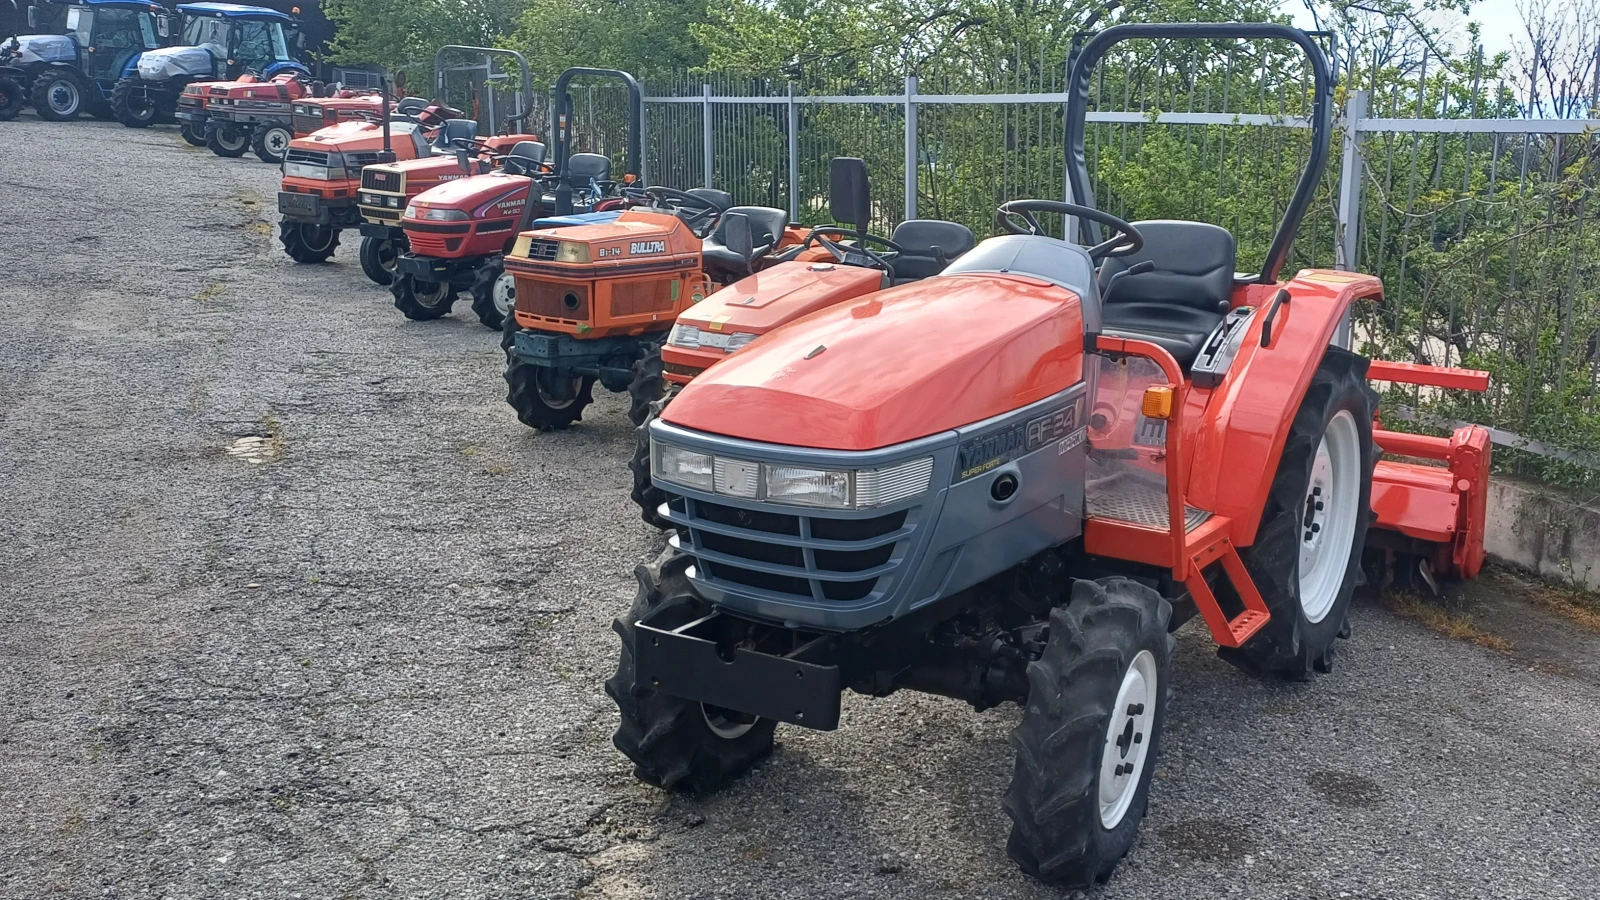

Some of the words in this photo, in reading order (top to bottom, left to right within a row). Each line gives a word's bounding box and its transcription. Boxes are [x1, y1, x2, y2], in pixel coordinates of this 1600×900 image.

[496, 199, 526, 209] YANMAR
[630, 240, 666, 255] BULLTRA
[961, 427, 1025, 469] YANMAR
[961, 465, 982, 478] SUPER
